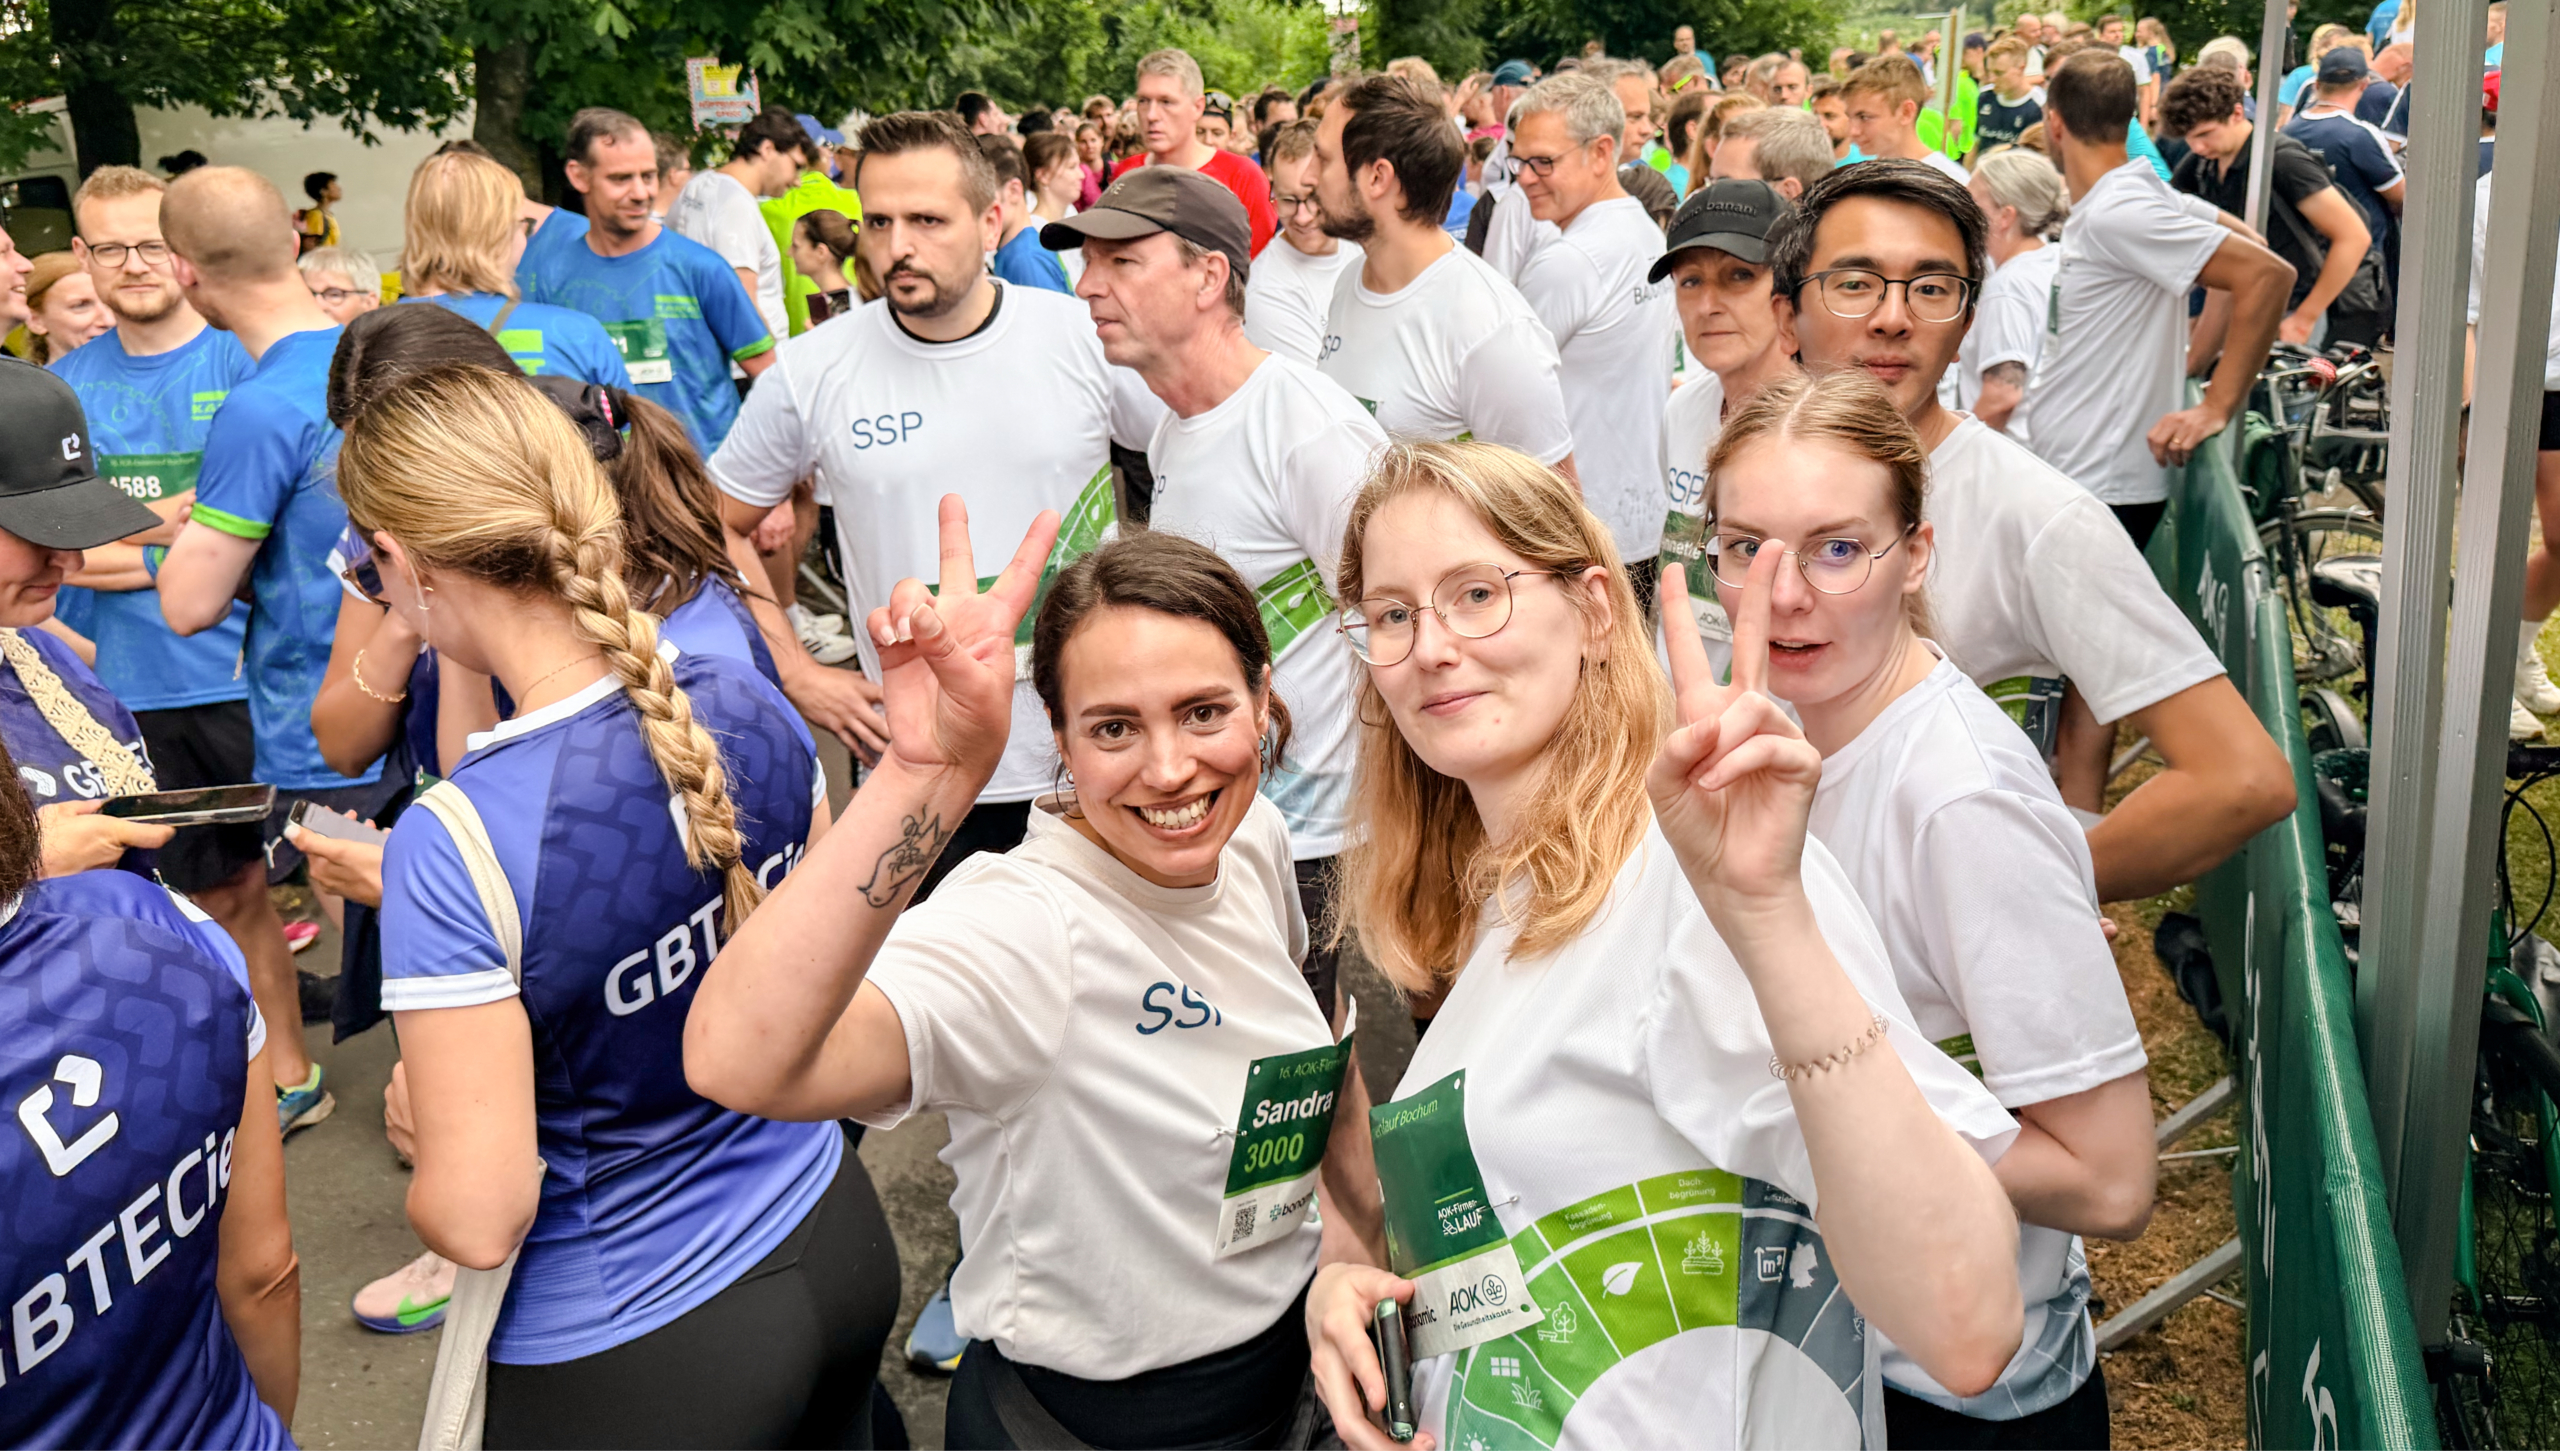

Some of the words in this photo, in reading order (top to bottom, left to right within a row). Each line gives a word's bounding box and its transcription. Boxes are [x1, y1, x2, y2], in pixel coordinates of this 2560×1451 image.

[851, 411, 923, 450] SSP
[1252, 1090, 1335, 1129] Sandra
[1400, 1099, 1439, 1127] Bochum
[1244, 1132, 1305, 1174] 3000
[1449, 1283, 1485, 1317] AOK
